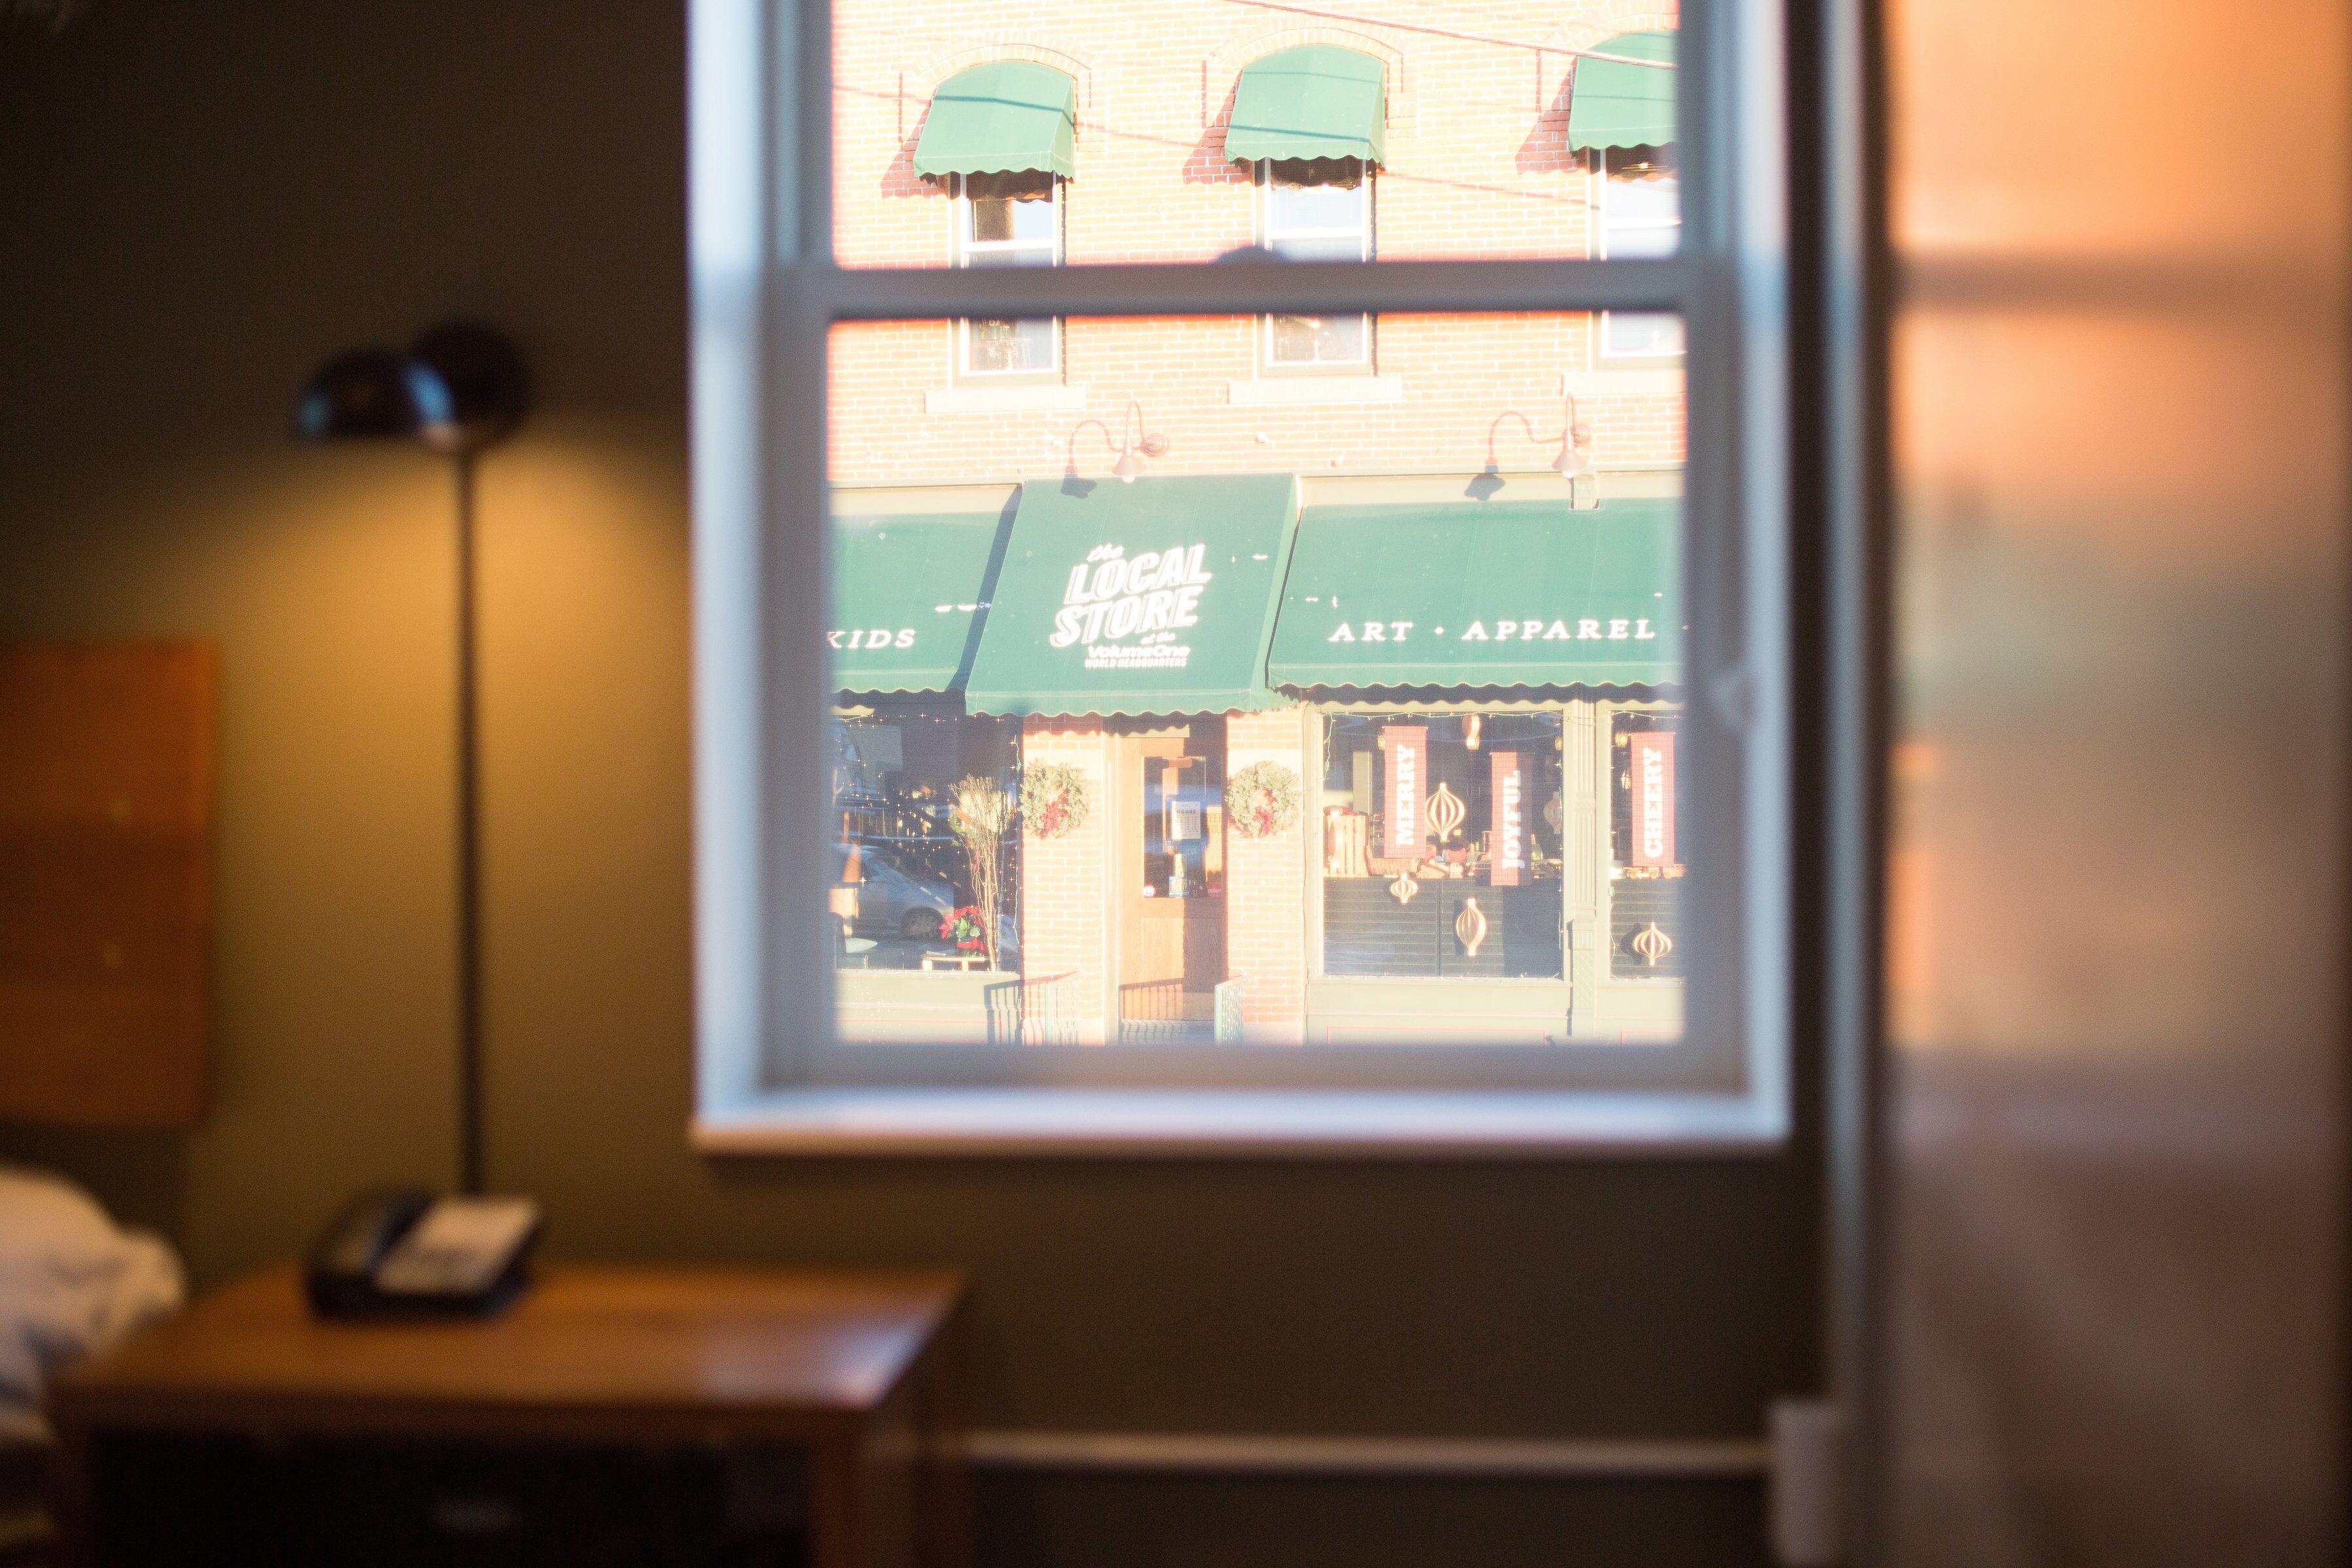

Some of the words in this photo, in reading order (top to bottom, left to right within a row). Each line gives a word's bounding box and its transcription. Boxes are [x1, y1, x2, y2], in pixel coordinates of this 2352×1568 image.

[1064, 543, 1211, 604] LOCAL
[1086, 544, 1124, 562] the
[827, 629, 916, 648] KIDS
[1049, 585, 1203, 647] STORE
[1328, 622, 1414, 642] ART
[1461, 619, 1656, 640] APPAREL
[1085, 658, 1116, 668] WORLD
[1117, 658, 1187, 668] HEADQUARTERS
[1396, 744, 1414, 846] MERRY
[1501, 770, 1524, 870] JOYFUL
[1643, 747, 1663, 858] CHEERY
